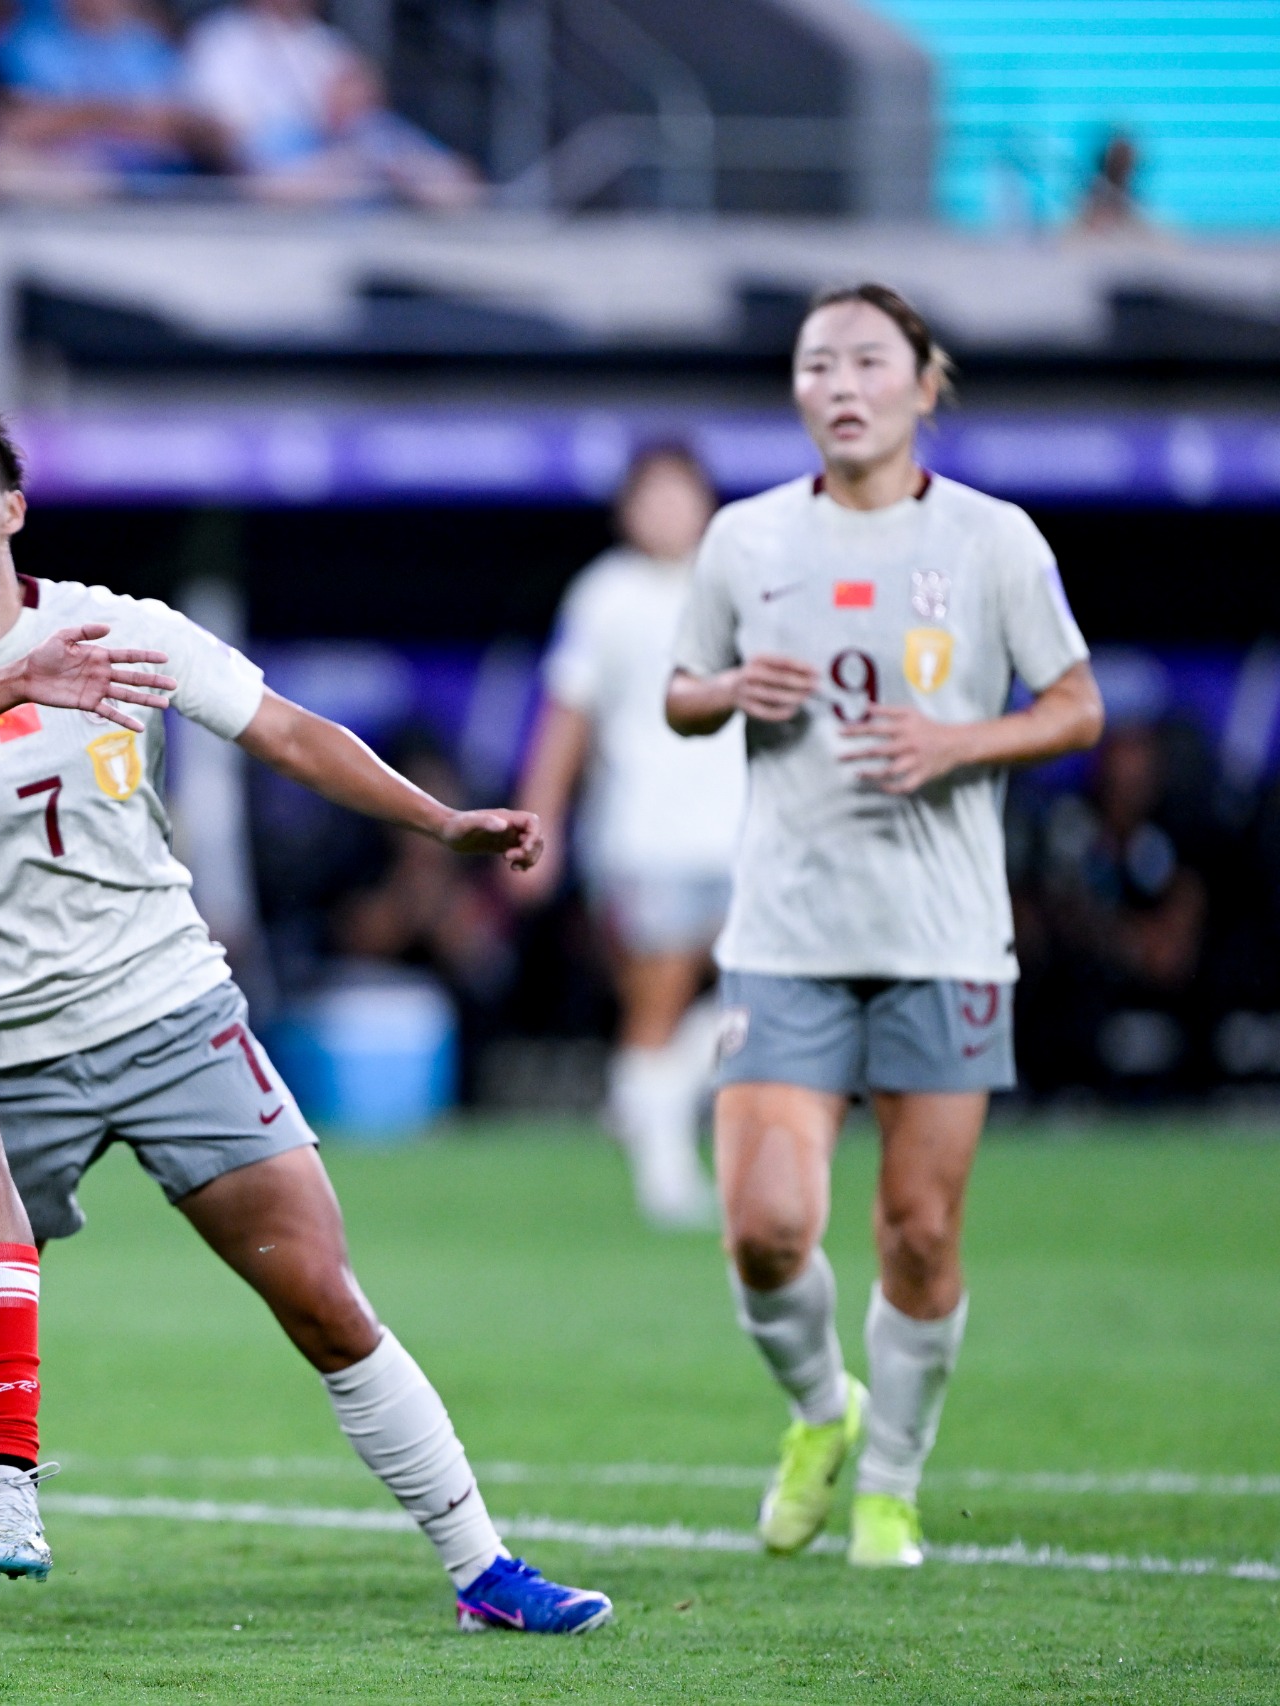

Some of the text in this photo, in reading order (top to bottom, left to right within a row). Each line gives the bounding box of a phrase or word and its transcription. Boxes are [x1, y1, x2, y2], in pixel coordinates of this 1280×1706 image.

[830, 646, 878, 726] 9
[16, 774, 65, 858] 7
[210, 1022, 272, 1094] 7
